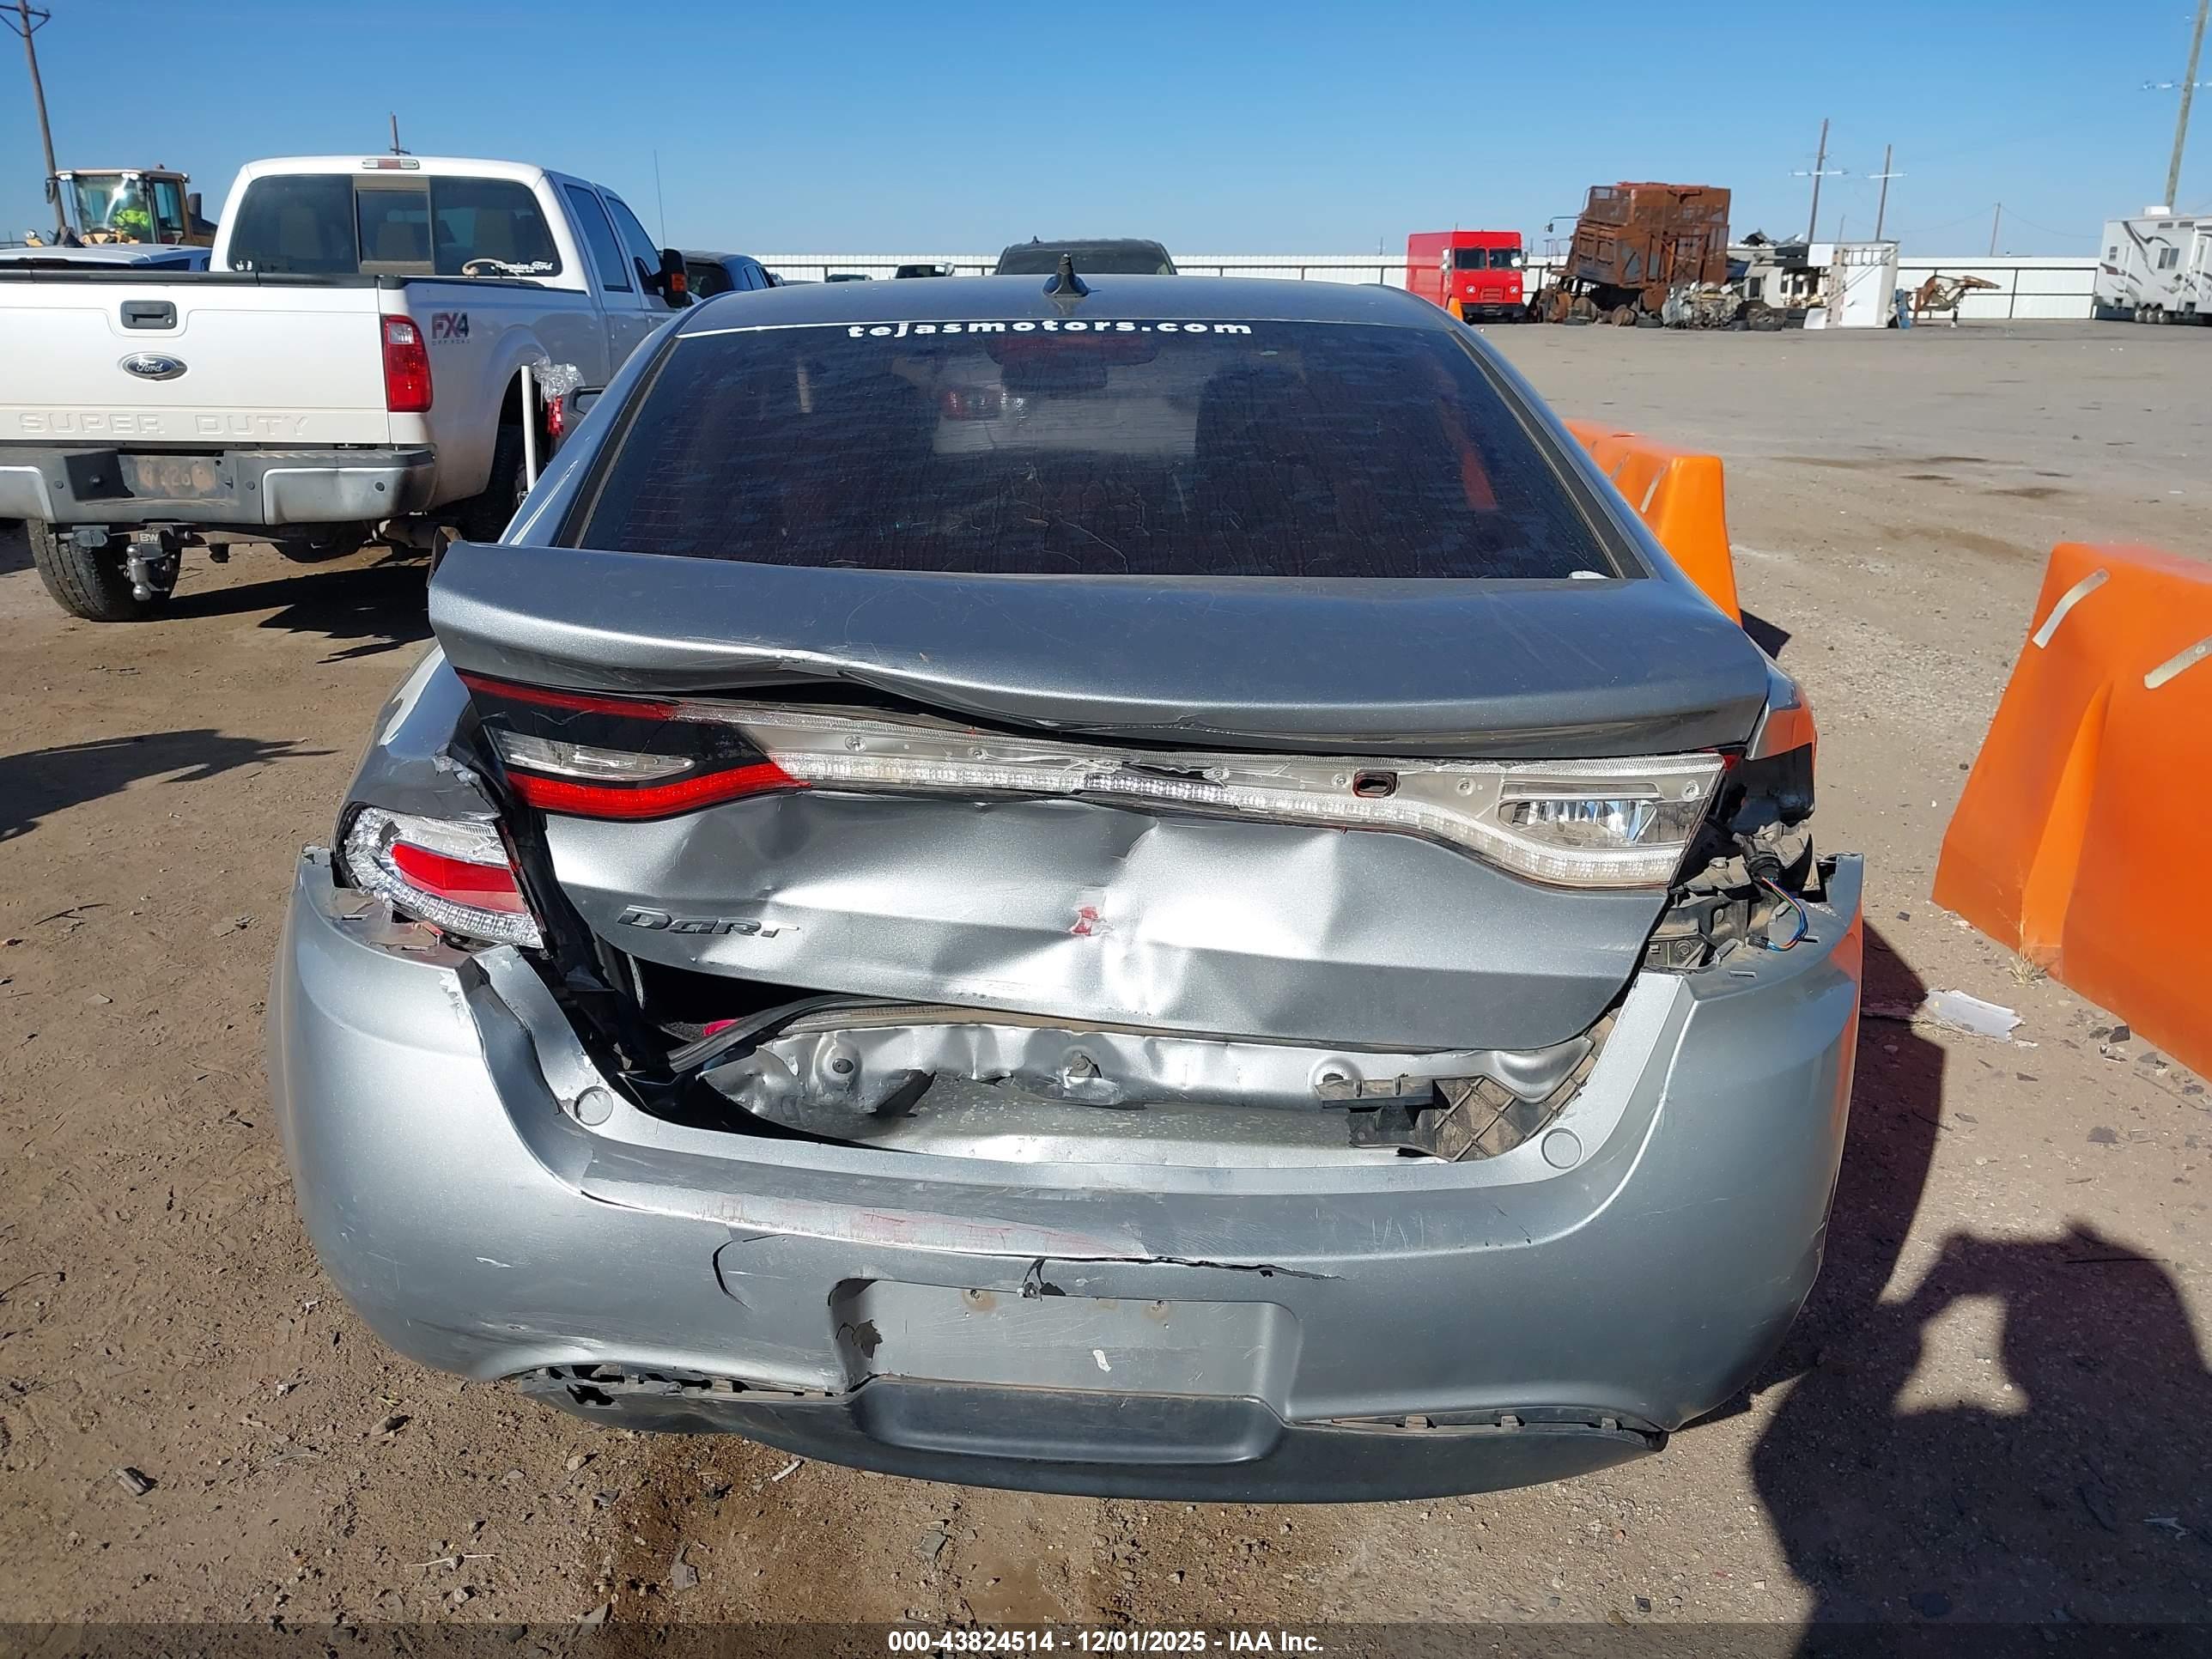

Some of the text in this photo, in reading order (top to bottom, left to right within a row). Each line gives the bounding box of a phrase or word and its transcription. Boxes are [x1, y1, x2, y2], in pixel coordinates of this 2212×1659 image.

[531, 261, 554, 270] Ford
[432, 312, 469, 339] FX4
[848, 321, 1253, 337] tejasmotors.com
[137, 356, 163, 372] Ford
[18, 412, 310, 435] SUPER DUTY
